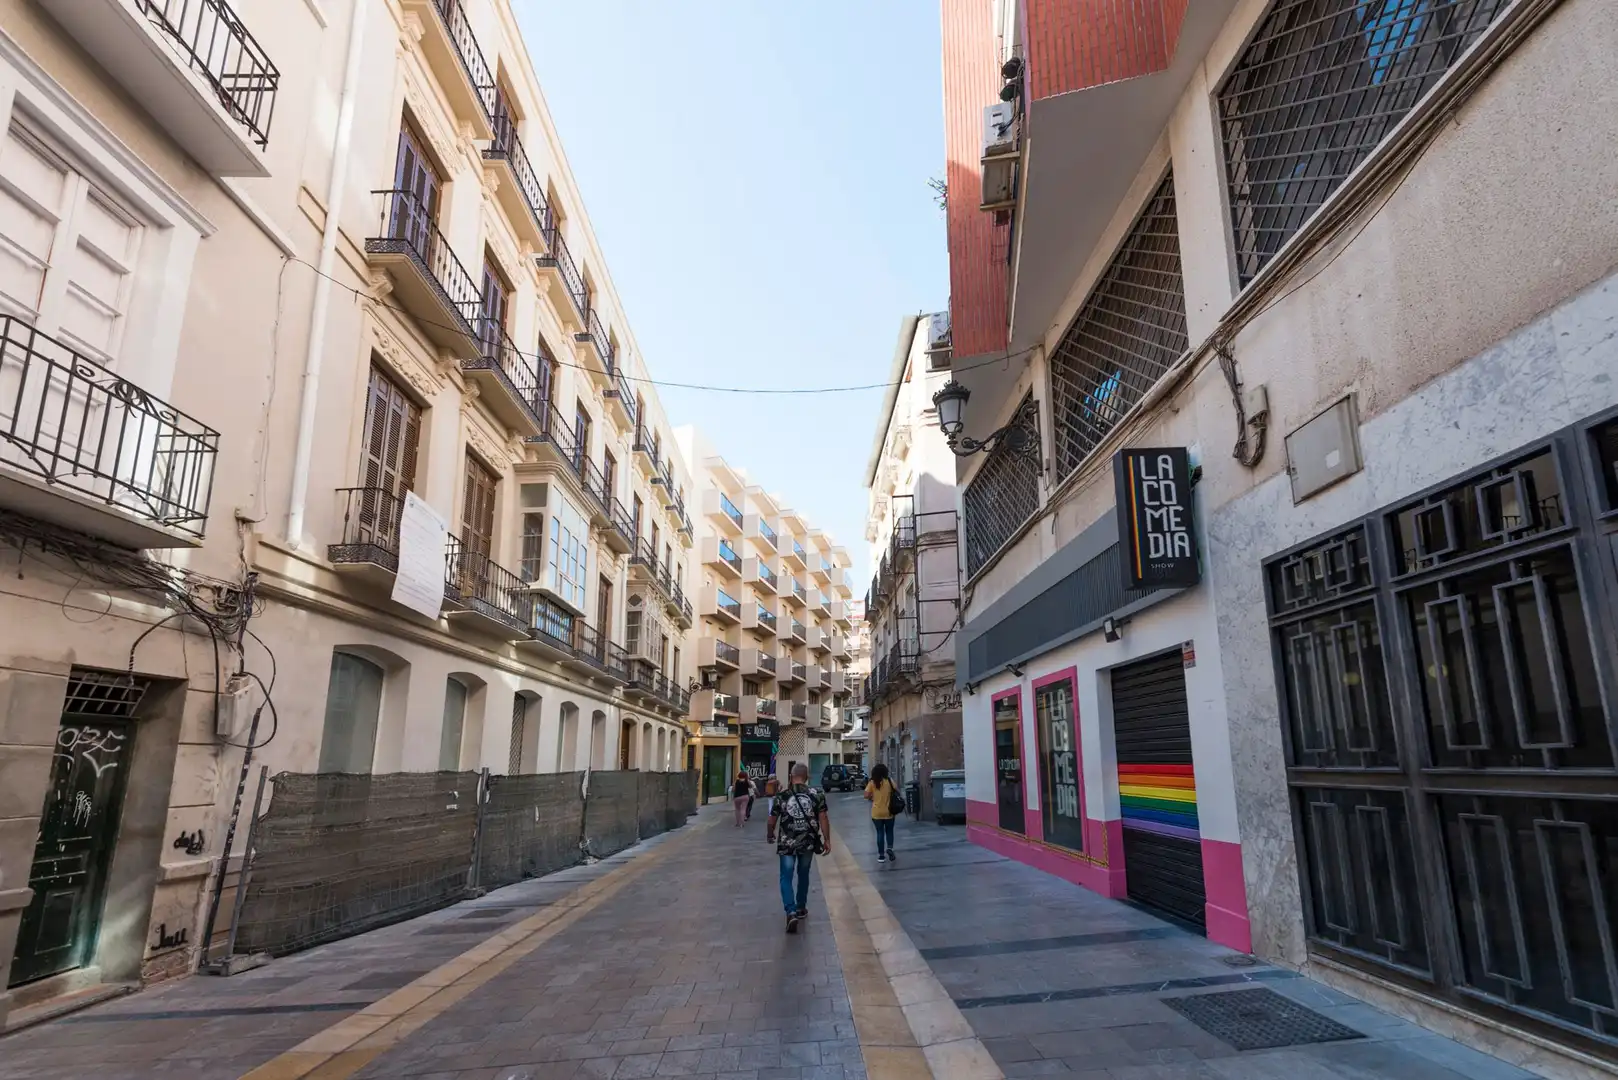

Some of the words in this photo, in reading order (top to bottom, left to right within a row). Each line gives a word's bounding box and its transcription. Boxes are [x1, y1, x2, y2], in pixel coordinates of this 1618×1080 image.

[1140, 455, 1174, 480] LA
[1142, 480, 1177, 506] CO
[1144, 505, 1186, 532] ME
[1147, 532, 1190, 558] DIA
[1049, 688, 1067, 720] LA
[753, 725, 771, 736] ROYAL
[746, 764, 768, 778] ROYAL
[1054, 751, 1075, 784] ME
[1056, 783, 1078, 818] DIA
